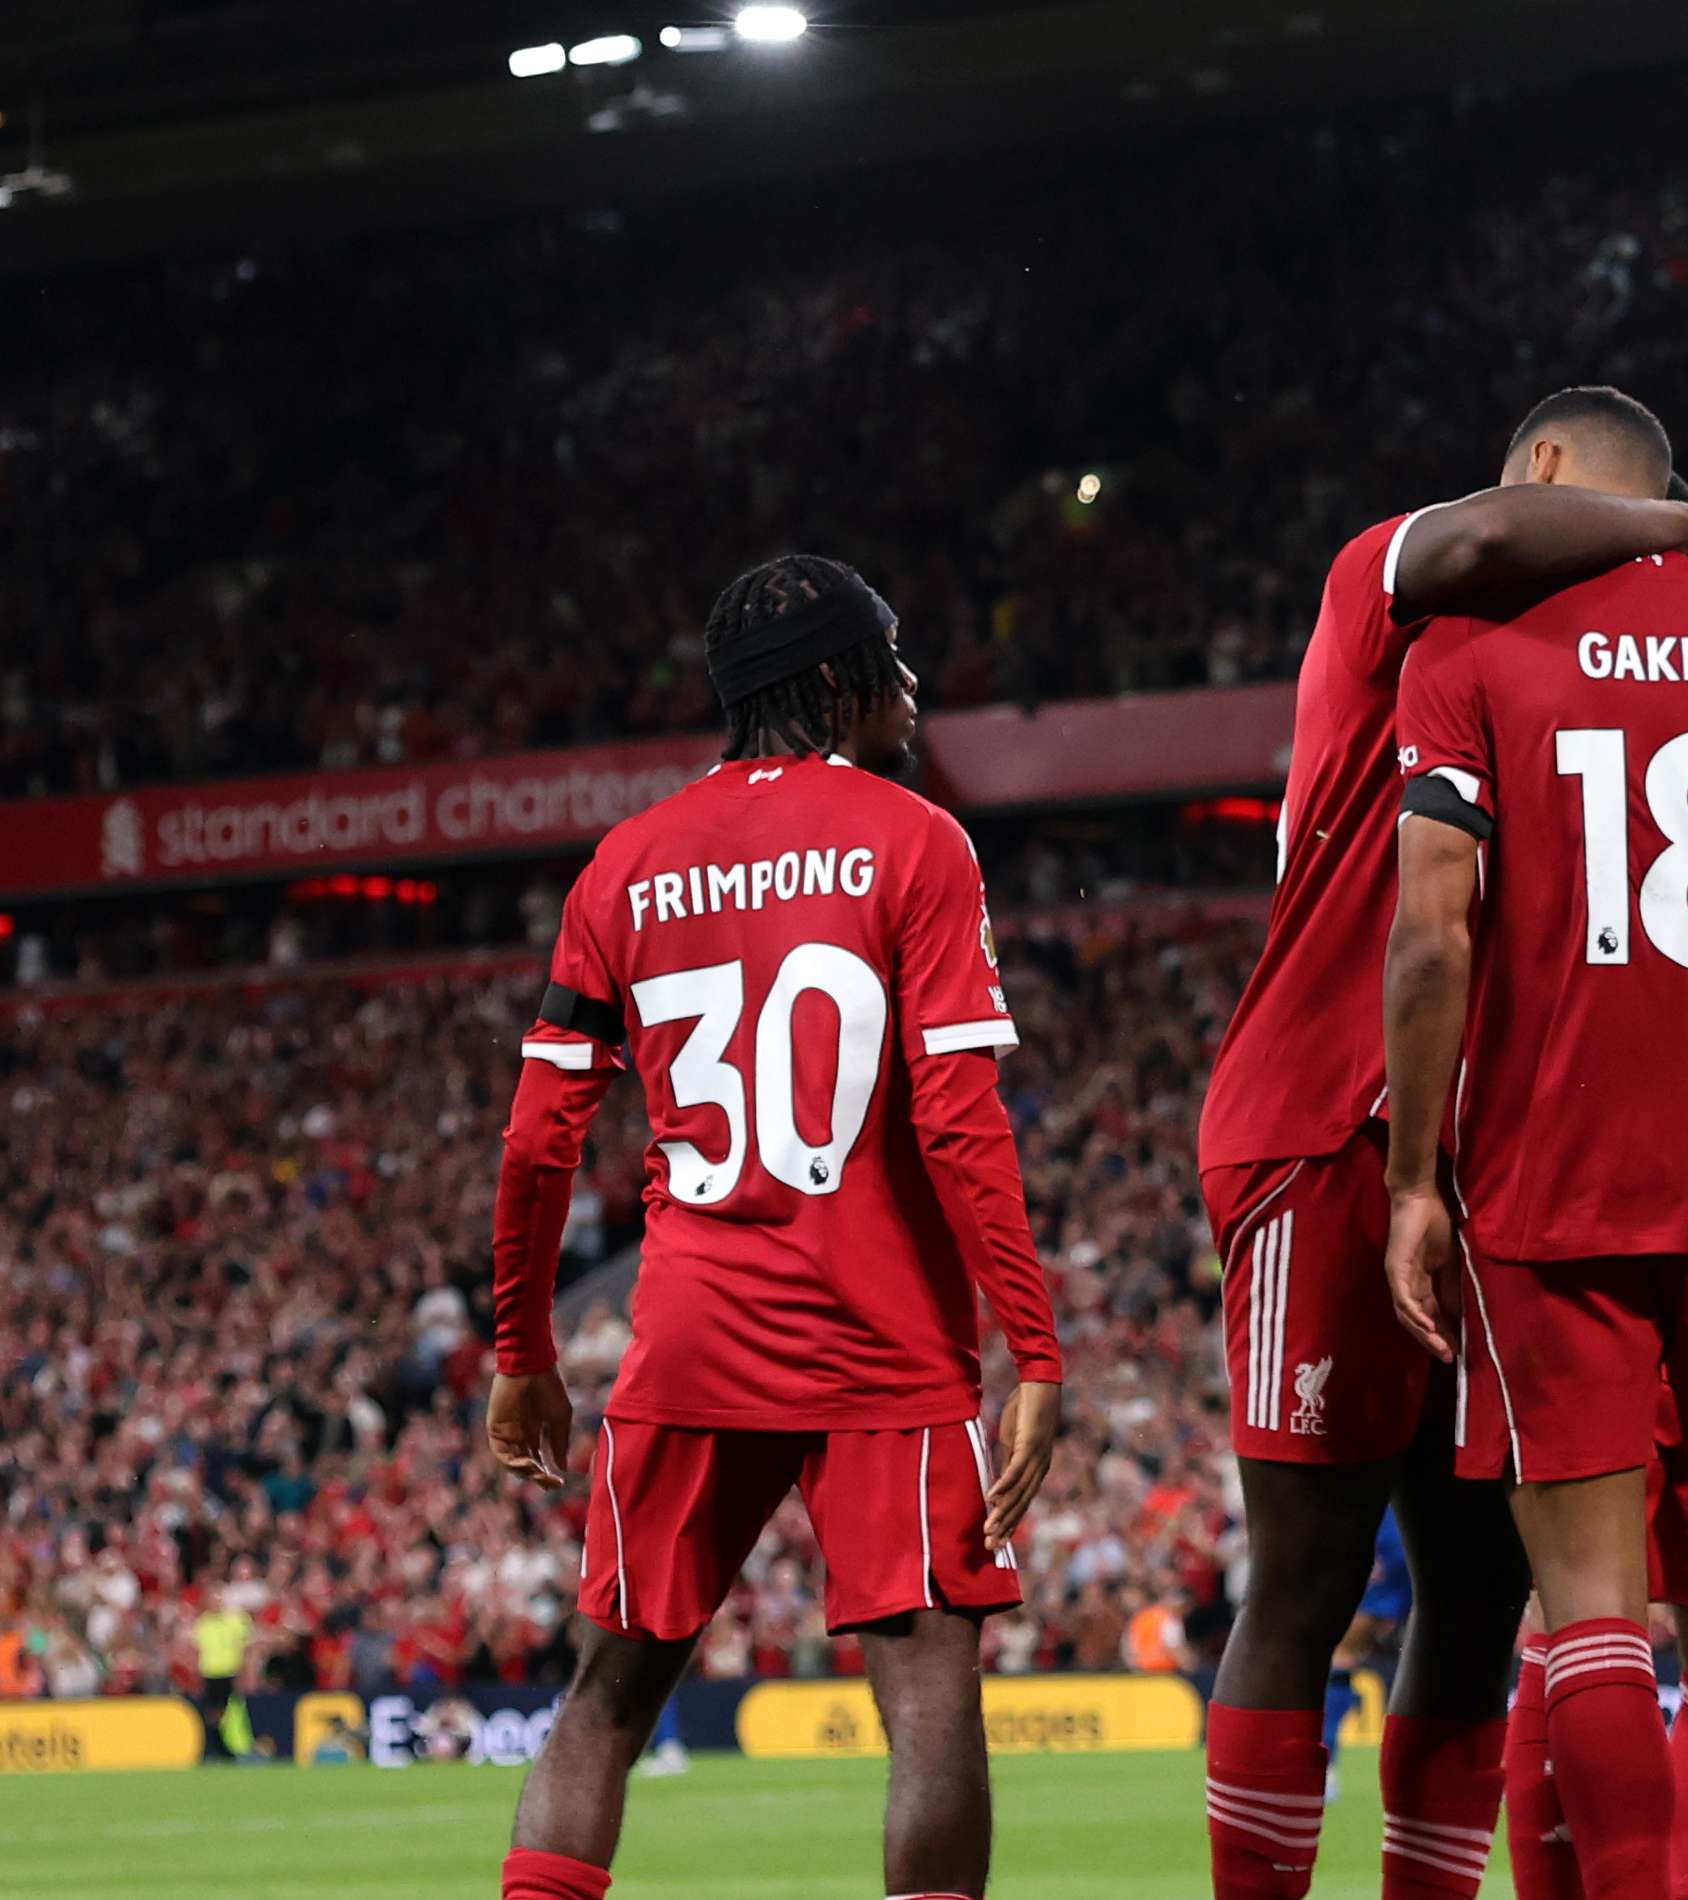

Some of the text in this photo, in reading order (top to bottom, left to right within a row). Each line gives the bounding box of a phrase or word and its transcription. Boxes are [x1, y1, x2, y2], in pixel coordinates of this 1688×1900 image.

[157, 778, 427, 866] standard
[627, 847, 875, 932] FRIMPONG
[629, 941, 888, 1205] 30
